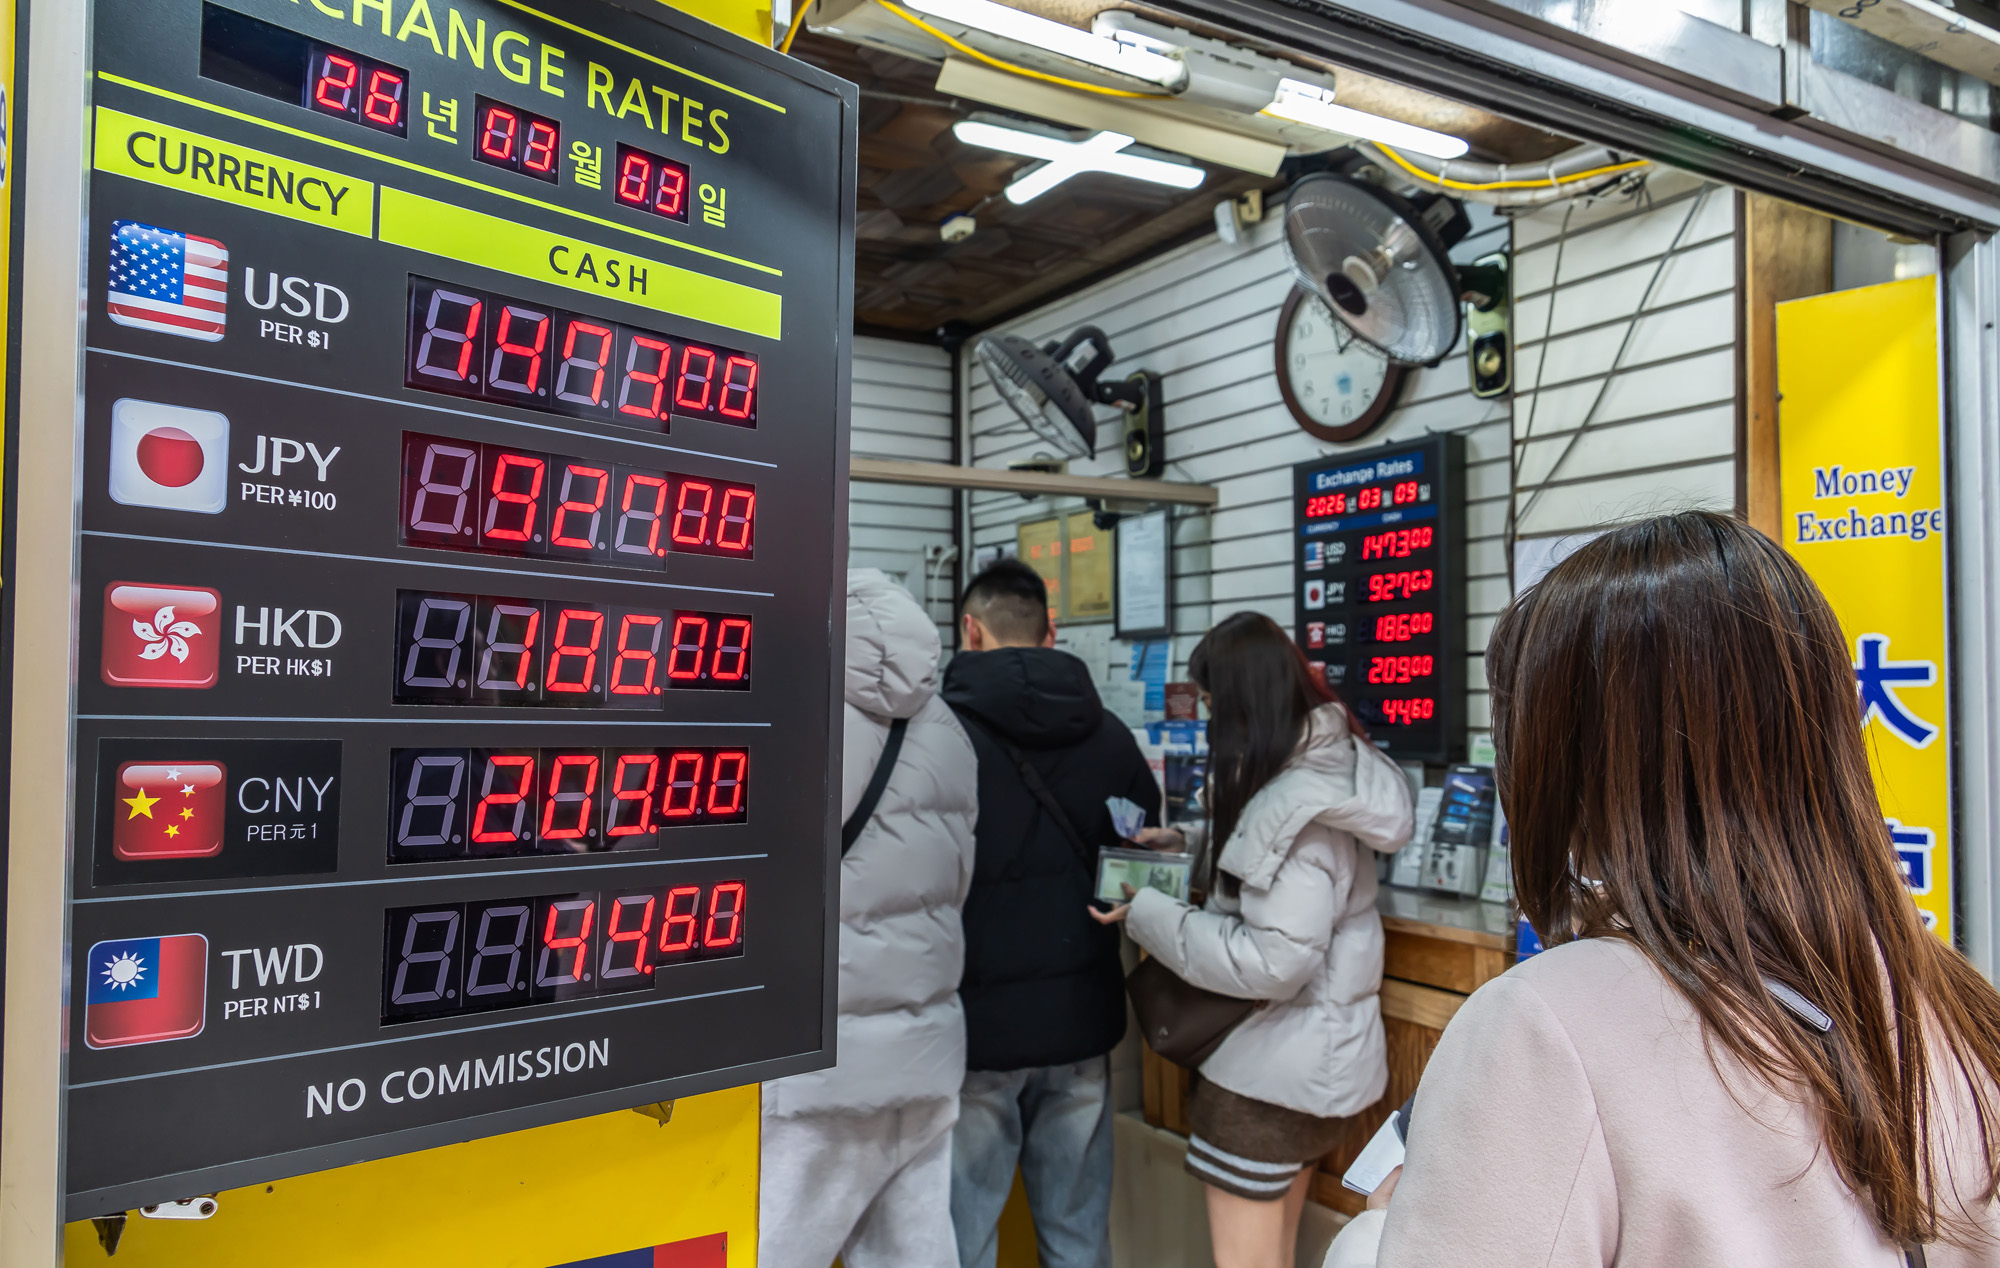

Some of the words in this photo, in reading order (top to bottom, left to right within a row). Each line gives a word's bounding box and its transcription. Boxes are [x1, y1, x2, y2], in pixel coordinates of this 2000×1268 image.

[290, 0, 566, 98] HANGE
[587, 61, 730, 155] RATES
[315, 54, 403, 126] 26
[422, 91, 458, 145] 년
[481, 108, 557, 172] 03
[568, 140, 602, 190] 월
[619, 154, 686, 214] 03
[699, 182, 727, 229] 일
[126, 130, 350, 217] CURRENCY
[548, 245, 648, 296] CASH
[244, 266, 350, 324] USD
[260, 319, 303, 345] PER
[307, 329, 330, 350] $1
[1297, 322, 1313, 340] 10
[1294, 353, 1306, 371] 9
[1320, 397, 1330, 416] 7
[1341, 399, 1353, 419] 6
[238, 434, 342, 482] JPY
[1316, 466, 1375, 491] Exchange
[1376, 459, 1415, 479] Rates
[1814, 466, 1914, 498] Money
[240, 482, 284, 505] PER
[288, 488, 337, 511] ¥100
[1306, 493, 1346, 518] 2026
[1358, 487, 1382, 510] 03
[1393, 481, 1418, 504] 09
[1796, 508, 1942, 542] Exchange
[1326, 581, 1346, 596] JPY
[234, 605, 343, 649] HKD
[236, 655, 281, 675] PER
[286, 658, 332, 677] HK$1
[238, 776, 335, 814] CNY
[247, 824, 286, 842] PER
[221, 943, 324, 990] TWD
[223, 997, 268, 1020] PER
[306, 1077, 367, 1118] NO
[380, 1038, 609, 1105] COMMISSION
